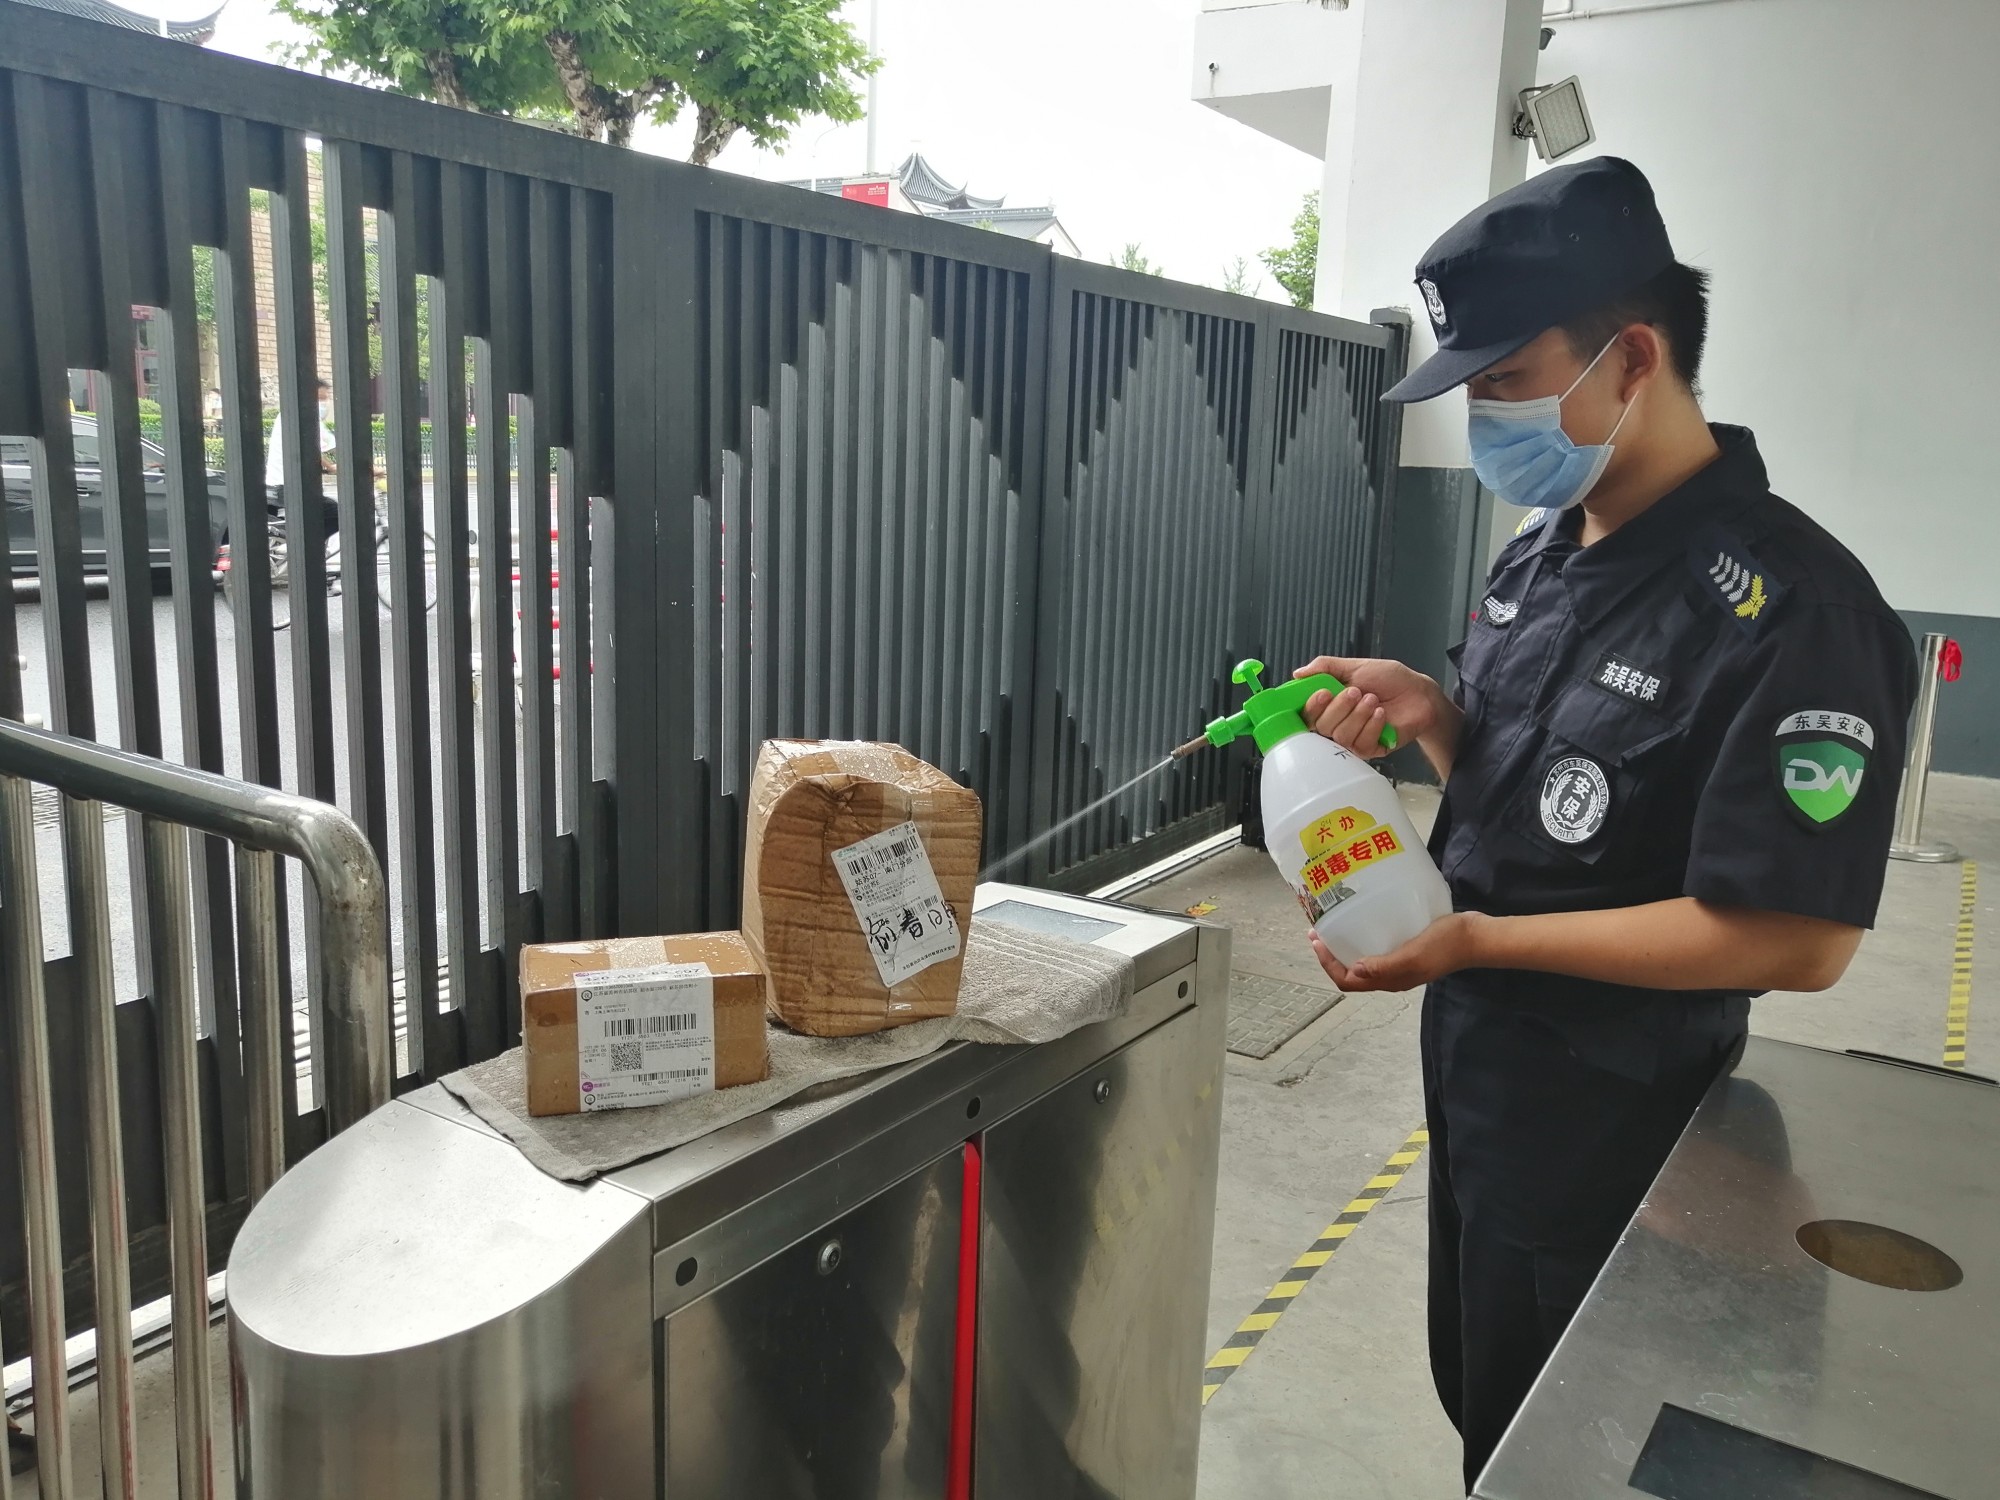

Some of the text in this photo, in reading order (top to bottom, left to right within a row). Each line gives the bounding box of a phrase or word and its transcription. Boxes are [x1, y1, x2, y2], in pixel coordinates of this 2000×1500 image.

[1600, 660, 1661, 701] 东吴安保
[1795, 714, 1866, 738] 东吴安保
[1783, 758, 1864, 797] DW
[1561, 775, 1592, 820] 安保
[1316, 815, 1356, 844] 六办
[1545, 813, 1577, 839] SECURITY
[1306, 830, 1397, 891] 消毒专用
